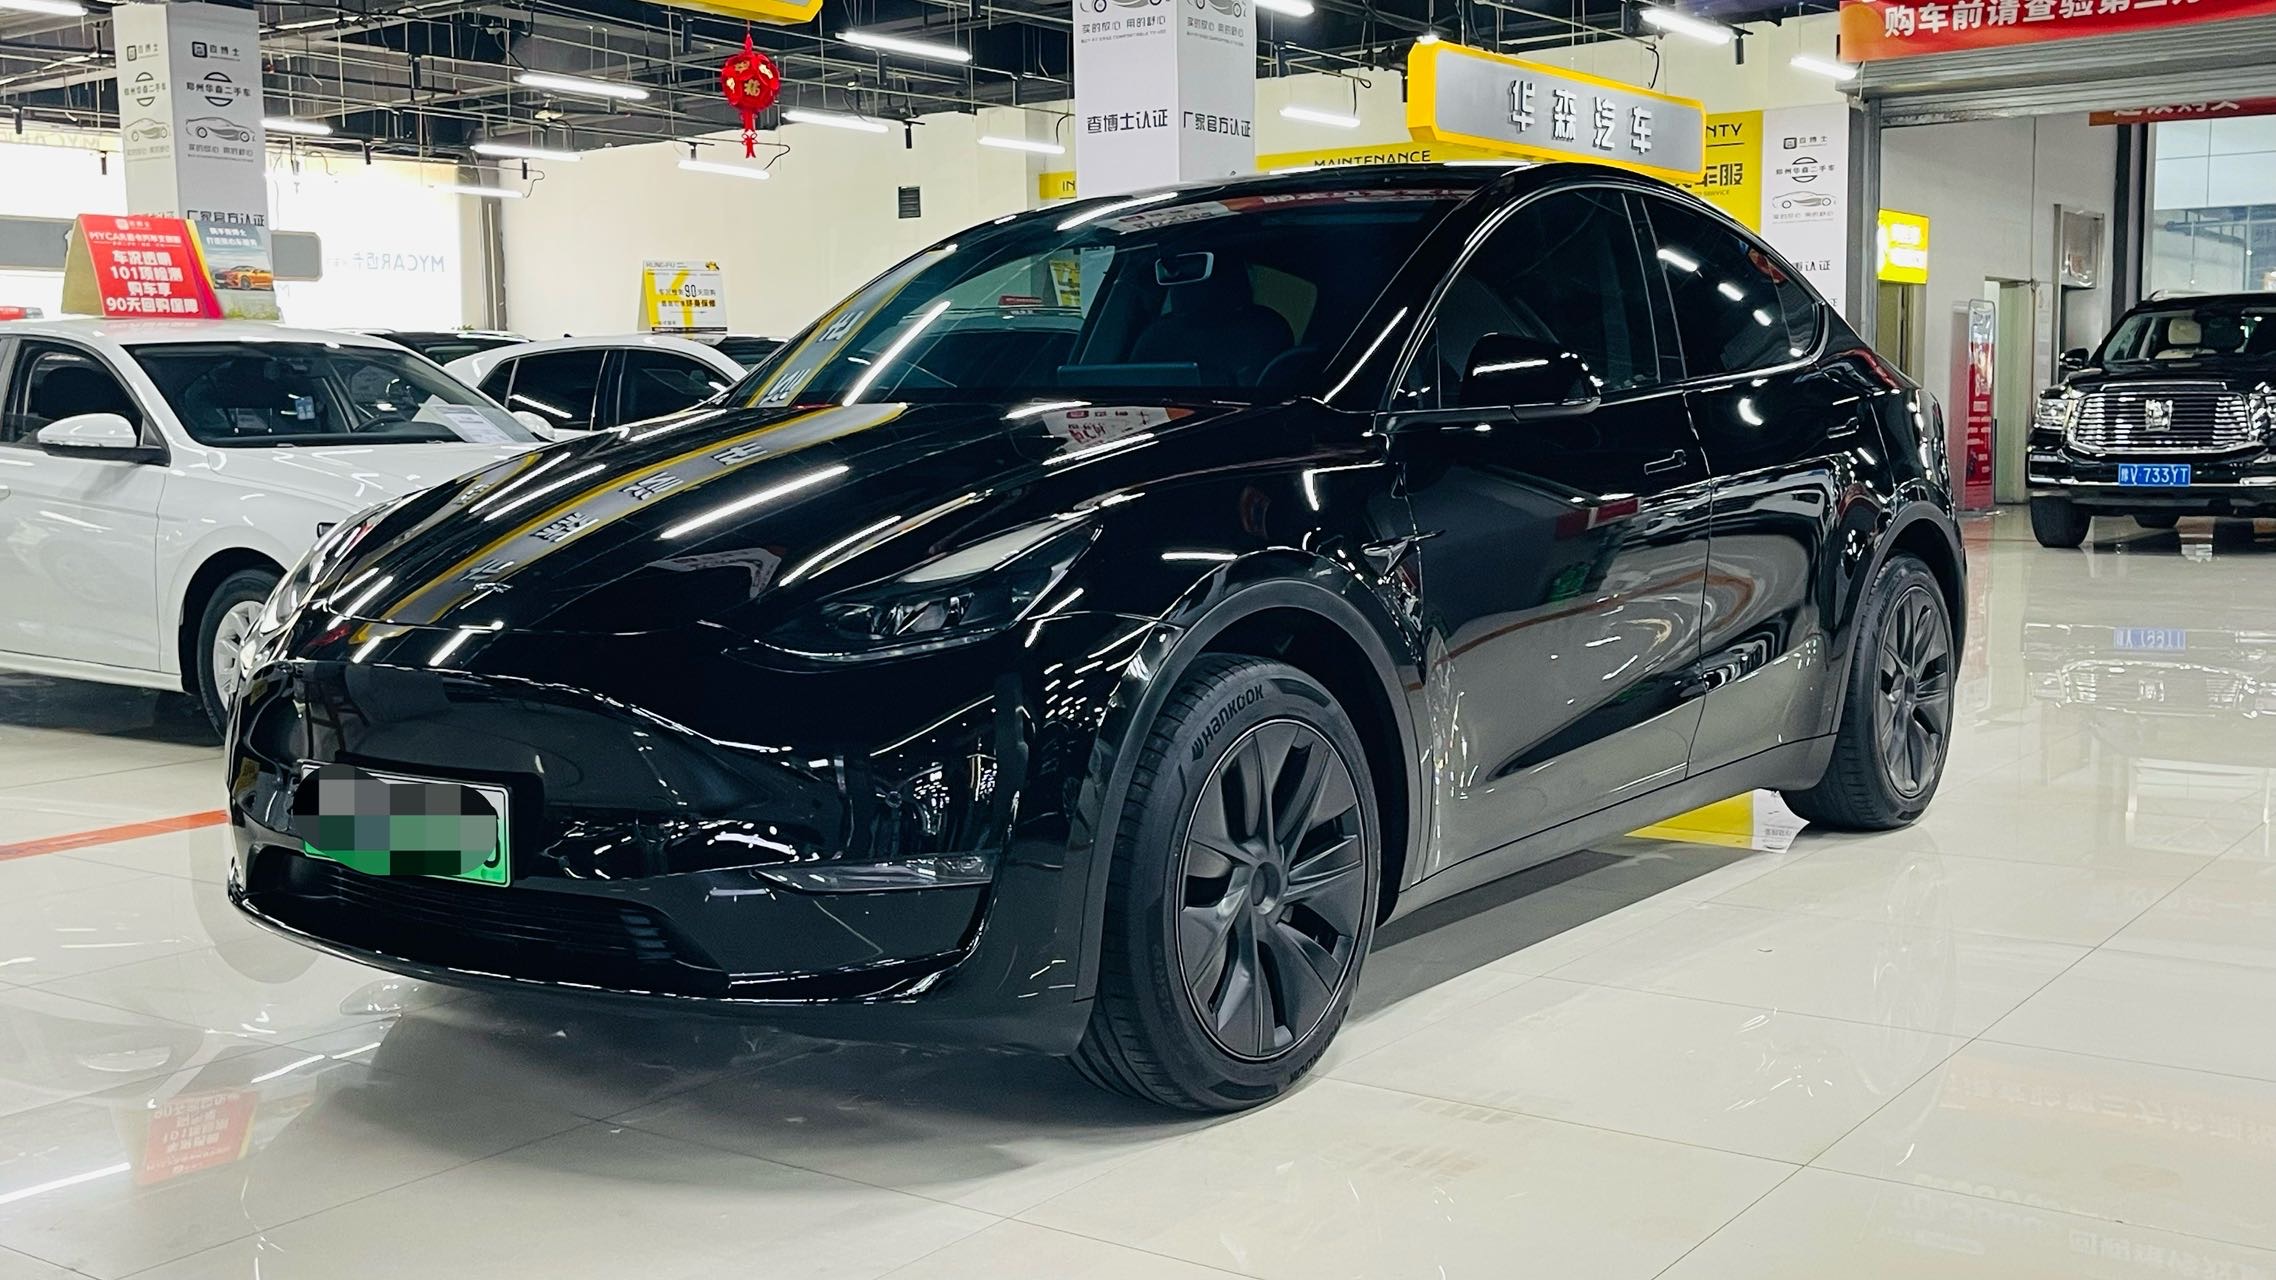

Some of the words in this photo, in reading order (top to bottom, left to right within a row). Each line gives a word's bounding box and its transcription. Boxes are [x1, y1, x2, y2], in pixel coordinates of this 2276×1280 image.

[1884, 0, 2199, 38] 购车前请查验
[186, 82, 252, 97] 郑州华森二手车
[1086, 108, 1169, 134] 查博士认证
[1183, 111, 1252, 137] 厂家官方认证
[1508, 79, 1653, 155] 华森汽车
[1314, 149, 1432, 167] MAINTENANCE
[112, 250, 173, 267] 车况透明
[110, 265, 184, 282] 101项检测
[106, 297, 199, 313] 90天回购保障
